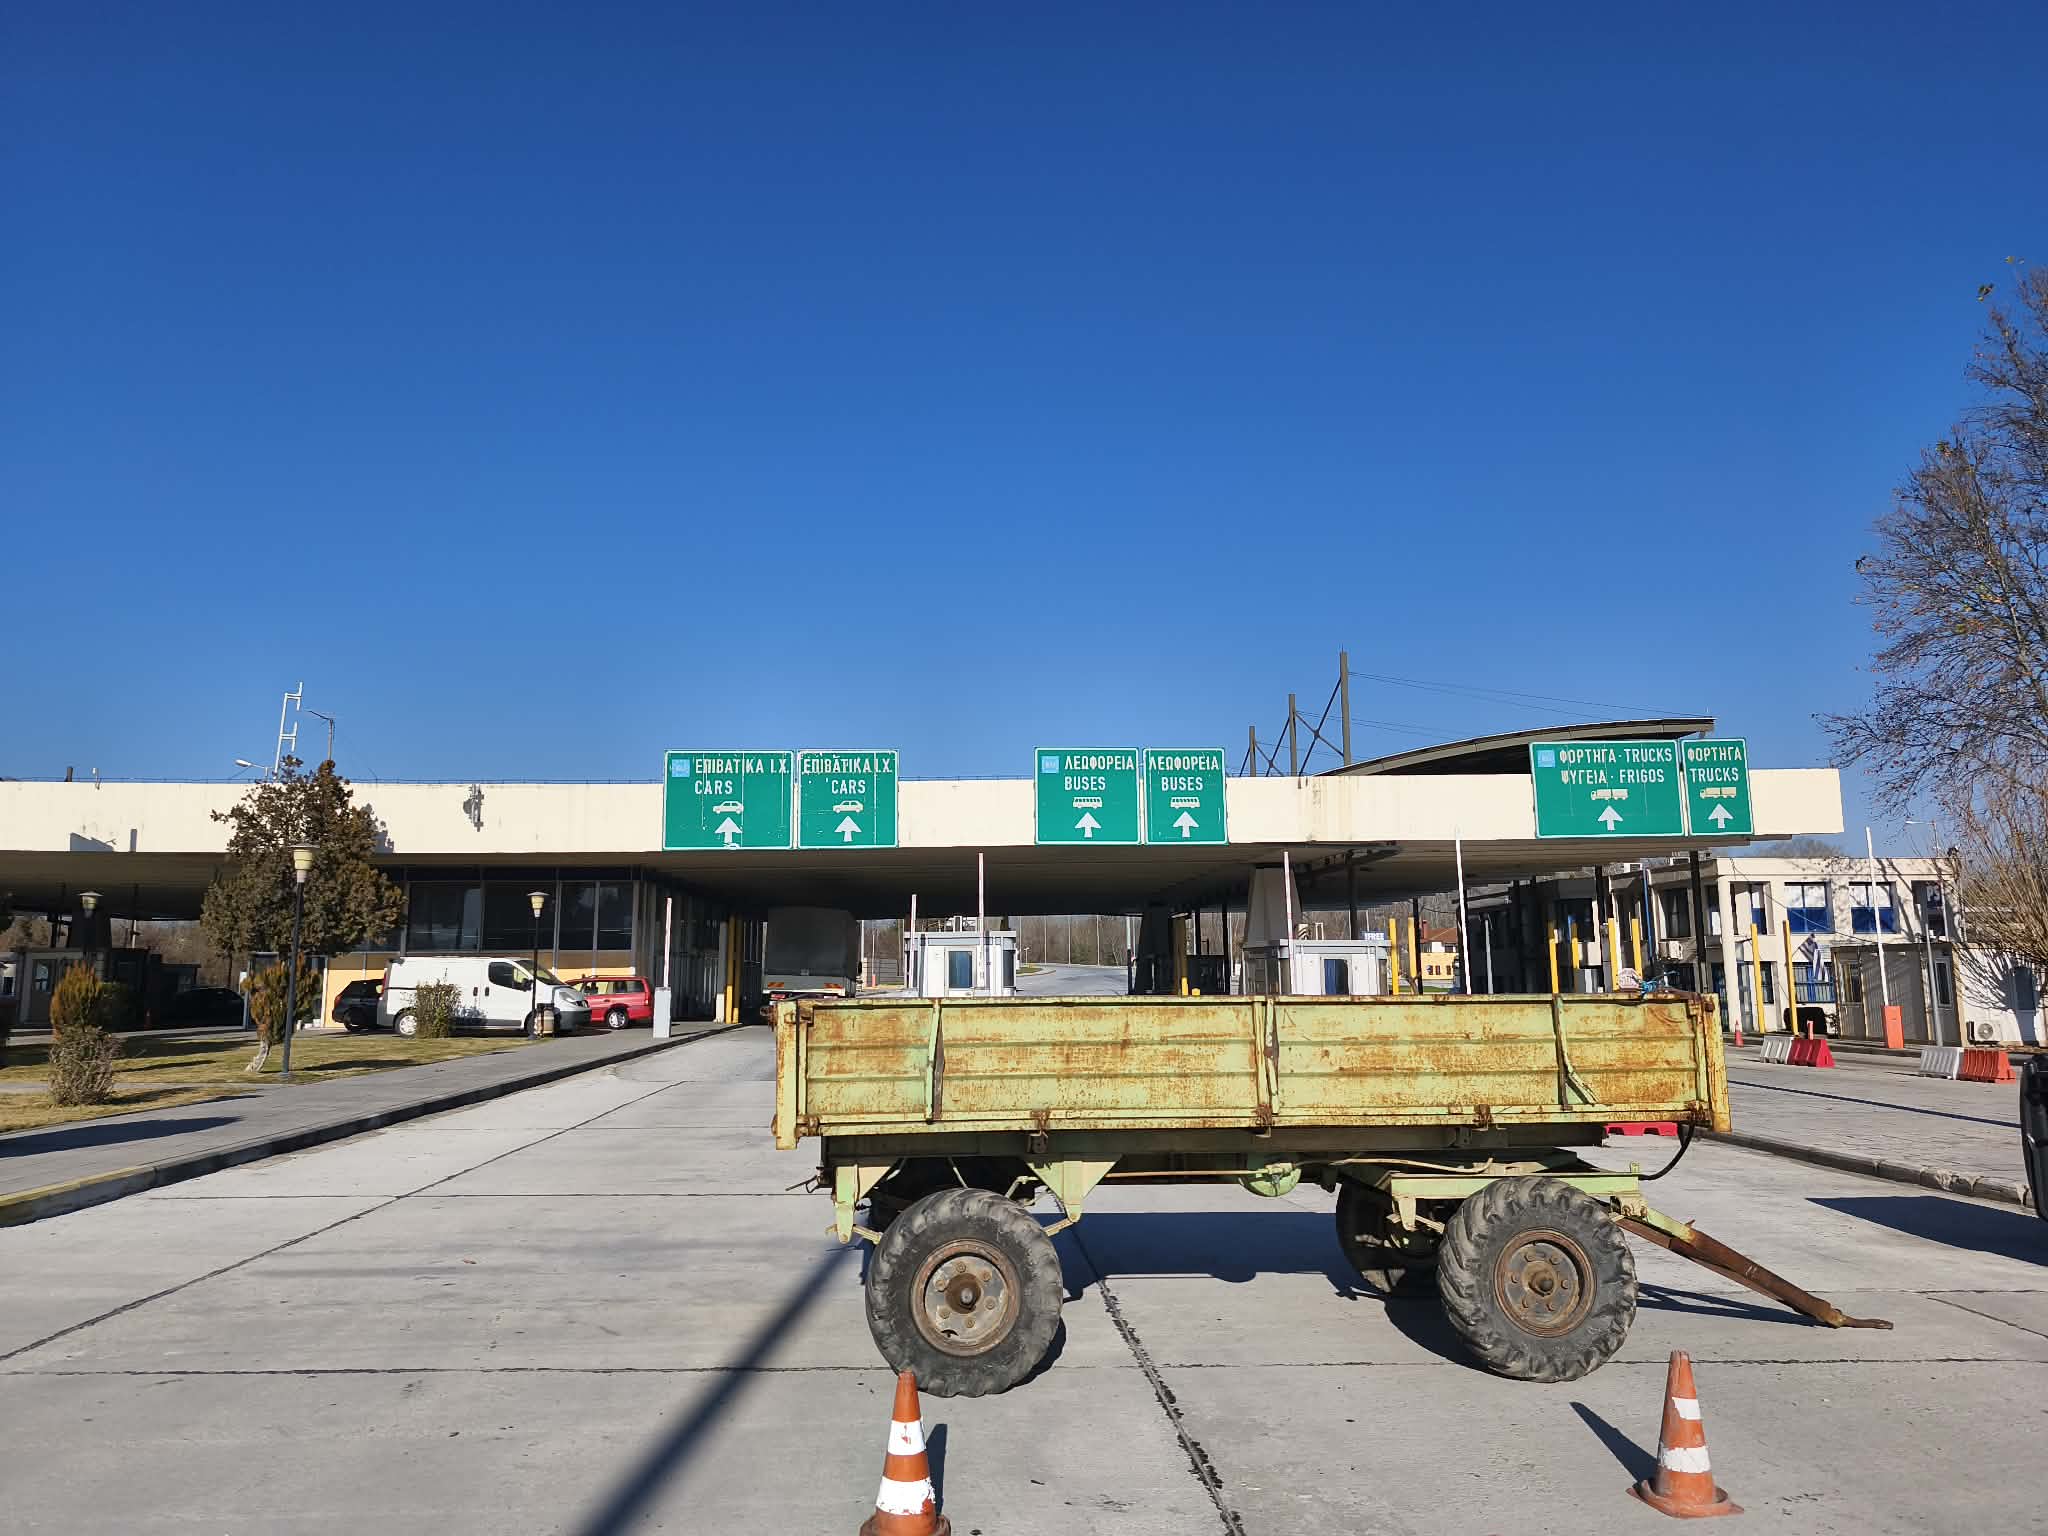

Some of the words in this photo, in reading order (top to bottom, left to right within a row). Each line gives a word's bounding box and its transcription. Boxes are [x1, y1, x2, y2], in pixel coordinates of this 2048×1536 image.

[1559, 748, 1616, 764] ΦΟΡΤΗΓΑ
[1623, 747, 1673, 763] TRUCKS
[1687, 746, 1742, 762] ΦΟΡΤΗΓΑ
[1064, 755, 1135, 770] ΛΕΩΦΟΡΕΙΑ
[1149, 755, 1220, 771] ΛΕΩΦΟΡΕΙΑ
[1064, 775, 1106, 791] BUSES
[1560, 769, 1607, 785] ΨΥΓΕΙΑ
[1619, 768, 1665, 784] FRIGOS
[1688, 767, 1739, 783] TRUCKS
[694, 780, 733, 795] CARS
[831, 779, 866, 795] CARS
[1161, 776, 1204, 792] BUSES
